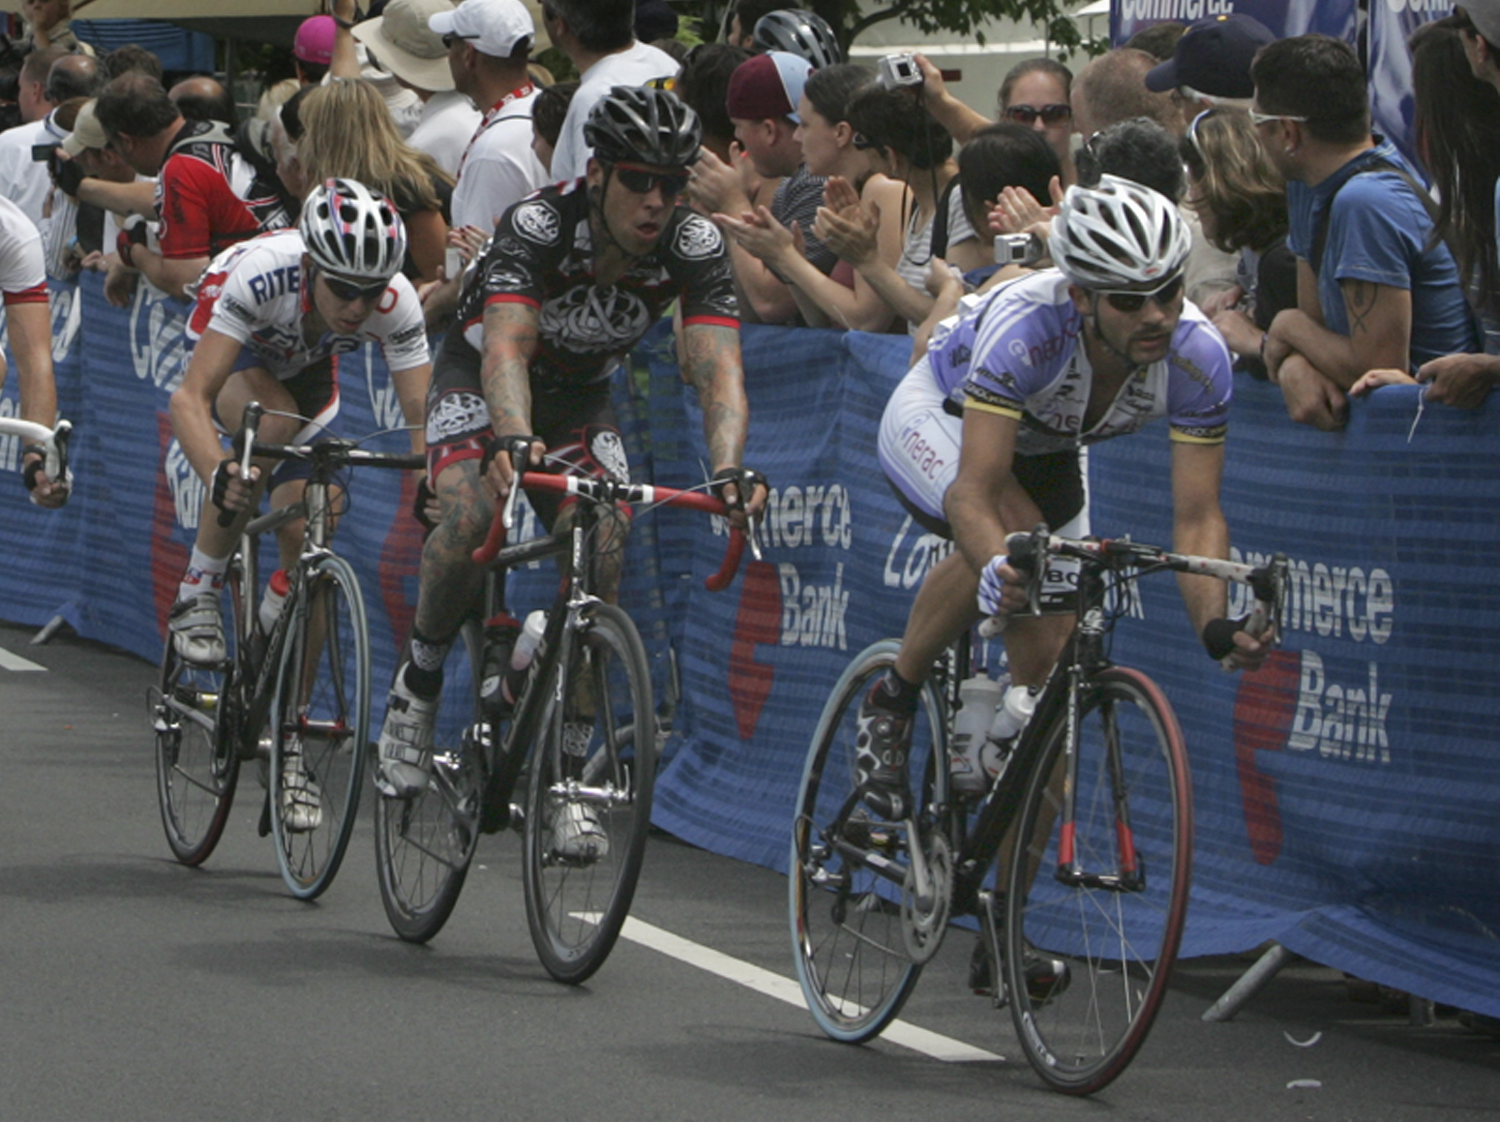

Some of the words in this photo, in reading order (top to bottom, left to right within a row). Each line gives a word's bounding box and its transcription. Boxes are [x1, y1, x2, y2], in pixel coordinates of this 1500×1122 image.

[248, 265, 300, 306] RITE
[902, 429, 945, 482] nerac
[778, 561, 850, 651] Bank
[1288, 649, 1393, 763] Bank
